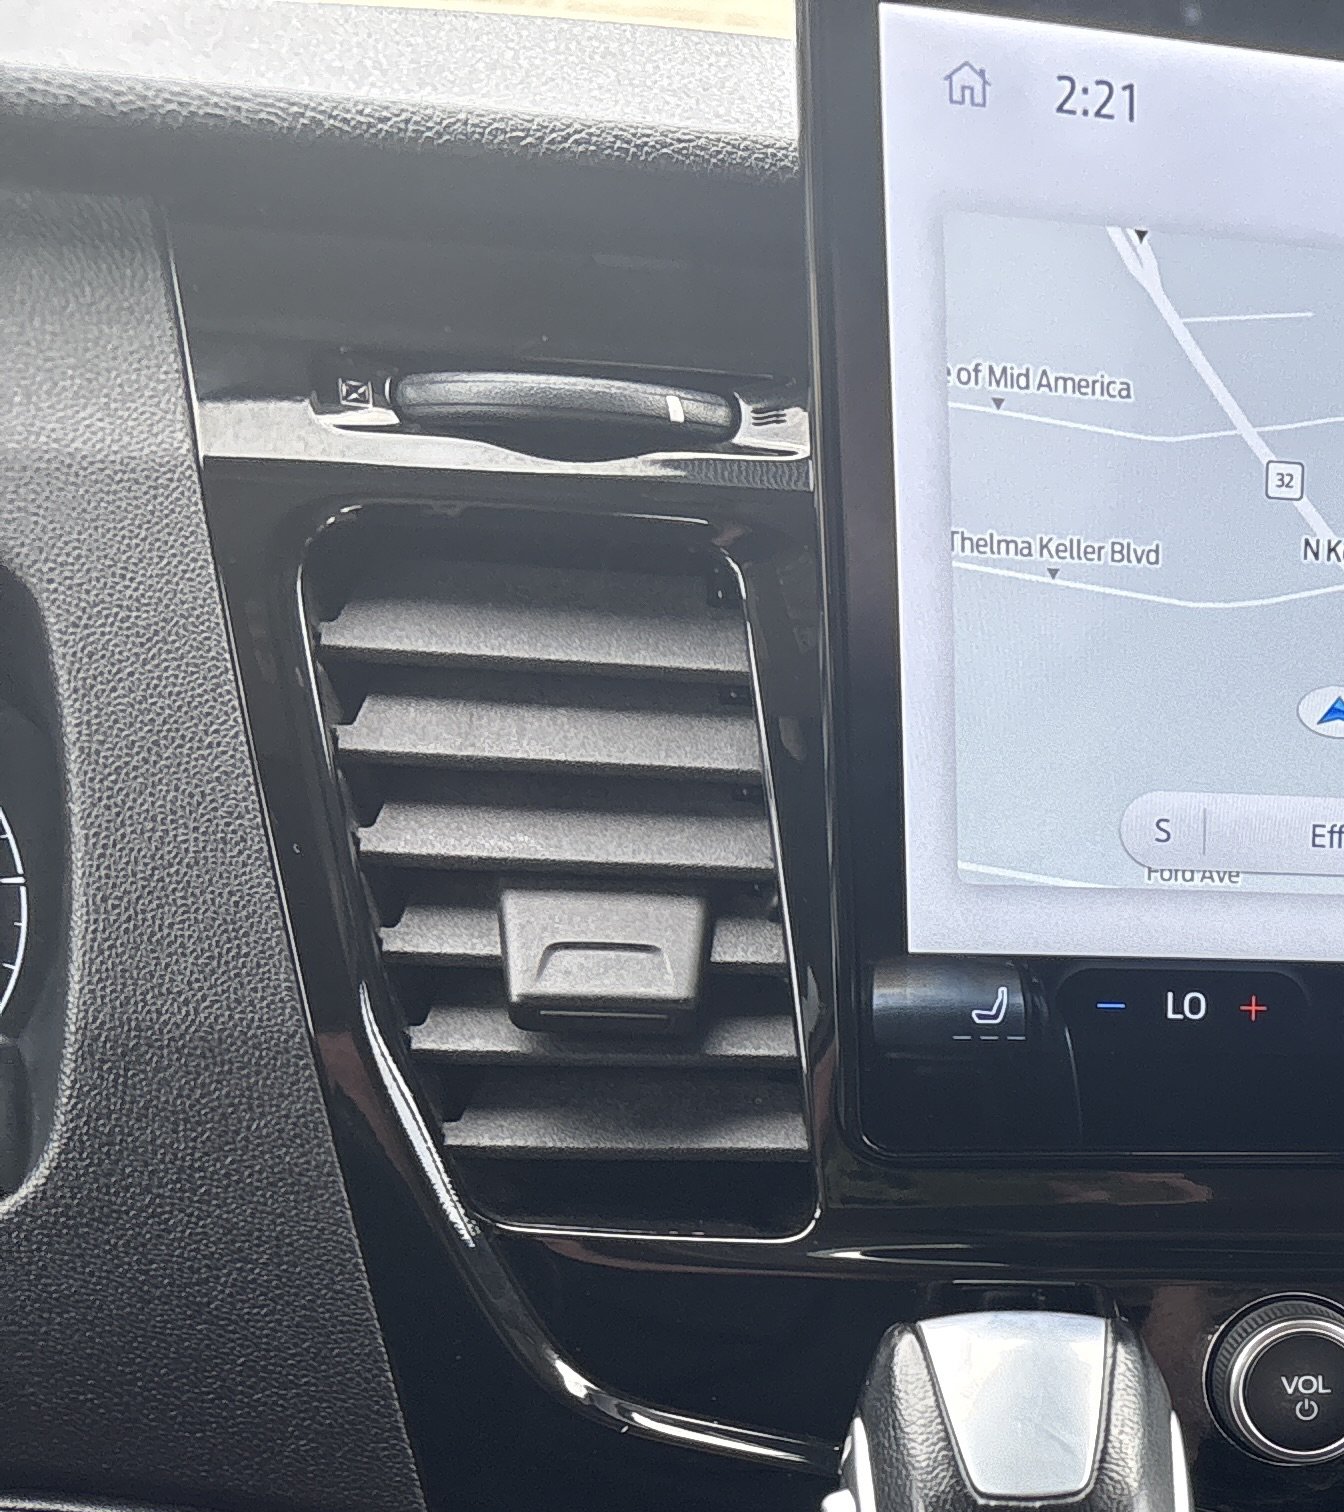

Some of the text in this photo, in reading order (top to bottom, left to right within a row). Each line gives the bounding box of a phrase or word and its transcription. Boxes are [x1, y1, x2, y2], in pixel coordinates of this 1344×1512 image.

[1055, 75, 1135, 123] 2:21
[956, 362, 982, 386] of
[988, 364, 1030, 391] Mid
[1036, 368, 1132, 400] America
[1275, 472, 1294, 489] 32
[950, 530, 1160, 566] Thelma Keller Blvd
[1303, 537, 1320, 561] N
[1154, 818, 1171, 843] S
[1167, 991, 1206, 1020] LO
[1280, 1375, 1332, 1395] VOL
